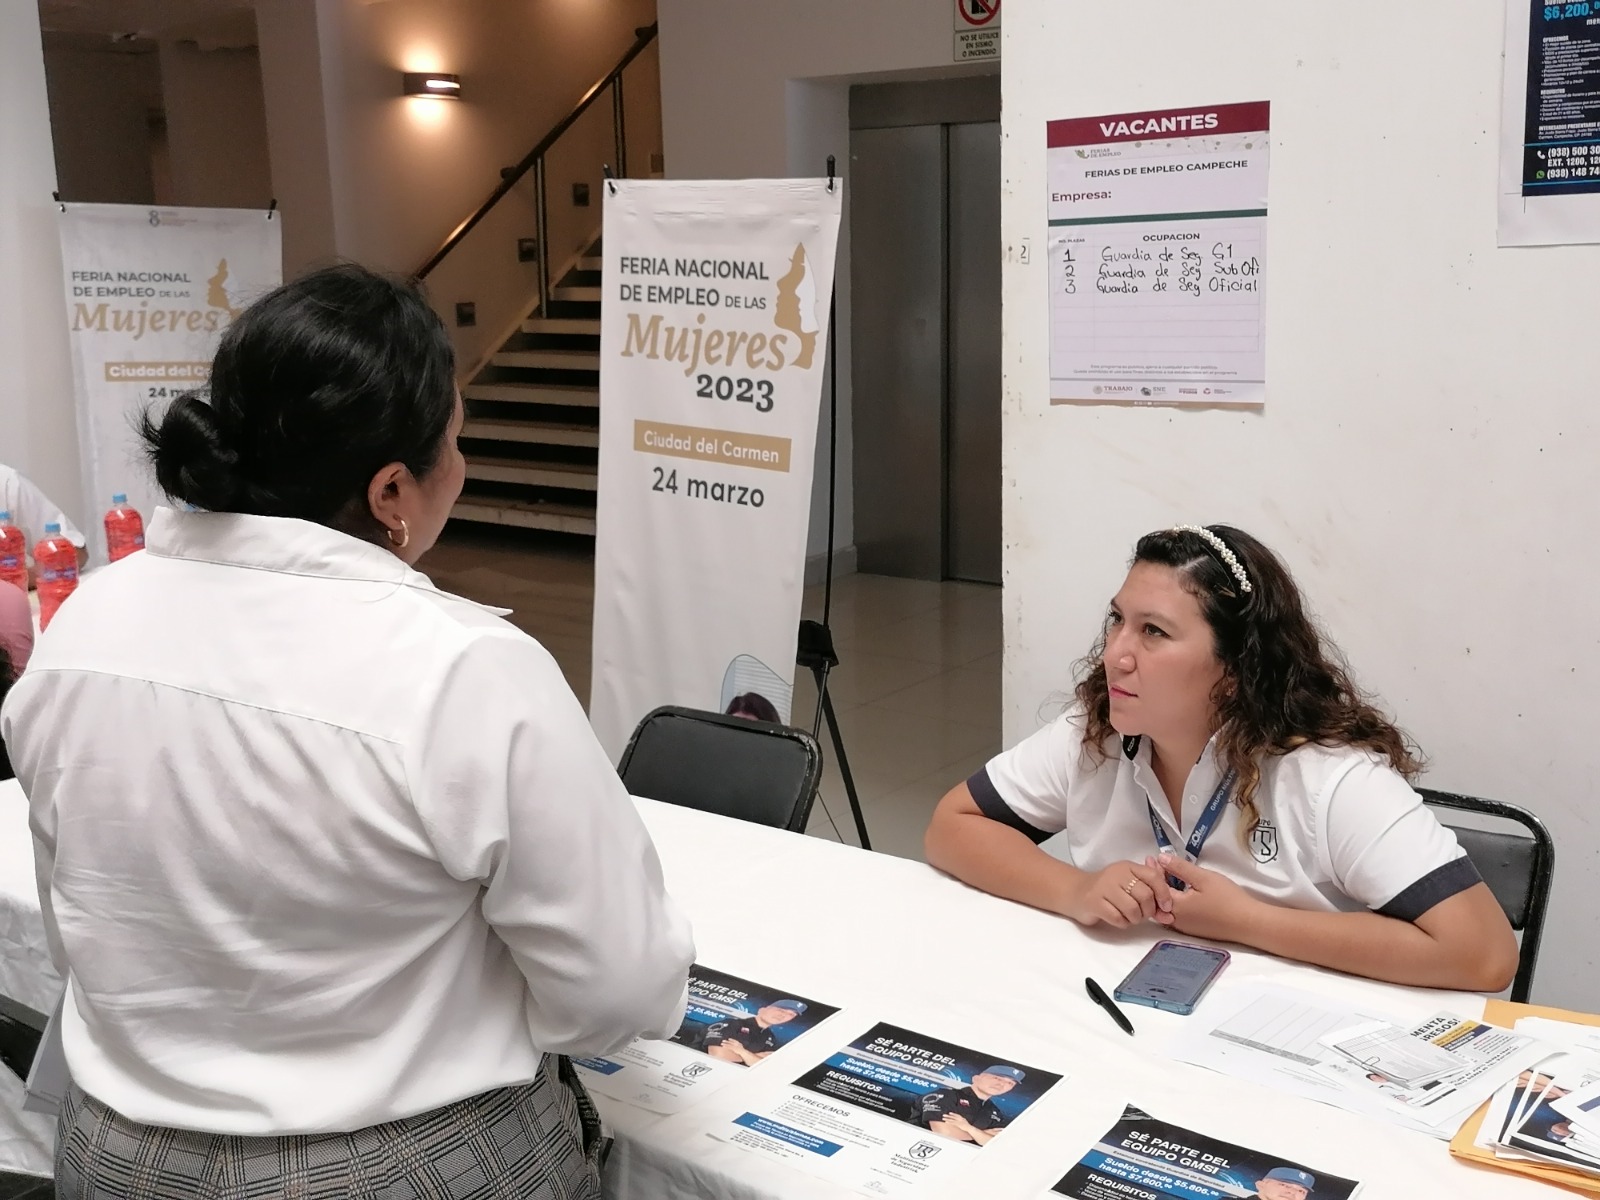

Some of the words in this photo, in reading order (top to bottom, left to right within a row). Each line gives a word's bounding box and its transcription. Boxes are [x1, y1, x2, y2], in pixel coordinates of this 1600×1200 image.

[978, 32, 999, 40] UTILICE
[968, 48, 996, 56] INCENDIO
[1099, 113, 1219, 137] VACANTES
[1548, 147, 1570, 158] (938)
[1571, 146, 1588, 156] 500
[1085, 168, 1121, 178] FERIAS
[1123, 167, 1137, 175] DE
[1140, 164, 1184, 175] EMPLEO
[1186, 160, 1249, 171] CAMPECHE
[1547, 158, 1564, 167] EXT.
[1566, 157, 1587, 166] 1200,
[1547, 168, 1569, 180] (938)
[1571, 167, 1587, 177] 148
[1052, 191, 1112, 203] Empresa:
[1143, 233, 1200, 242] OCUPACION
[1063, 249, 1076, 262] 1
[1102, 246, 1152, 262] Guardia
[1158, 247, 1173, 262] de
[72, 271, 112, 282] FERIA
[118, 272, 191, 283] NACIONAL
[620, 257, 670, 277] FERIA
[674, 259, 769, 281] NACIONAL
[1065, 265, 1075, 278] 2
[1099, 264, 1146, 280] Guardia
[1155, 264, 1169, 277] de
[1182, 263, 1201, 280] Seg
[73, 286, 93, 298] DE
[97, 286, 155, 298] EMPLEO
[159, 290, 171, 298] DE
[1065, 279, 1076, 294] 3
[1097, 277, 1138, 294] Guardia
[1152, 278, 1167, 292] de
[1179, 278, 1200, 296] Seg
[1209, 276, 1257, 293] Oficial
[620, 284, 642, 302] DE
[647, 286, 720, 306] EMPLEO
[724, 295, 741, 308] DE
[744, 296, 767, 310] LAS
[72, 301, 221, 341] Mujeres
[620, 312, 788, 378] Mujeres
[109, 364, 166, 378] Ciudad
[168, 364, 191, 377] del
[149, 387, 167, 398] 24
[696, 374, 774, 412] 2023
[644, 430, 692, 452] Ciudad
[695, 437, 718, 455] del
[722, 441, 779, 464] Carmen
[652, 466, 678, 494] 24
[687, 477, 764, 508] marzo
[1210, 790, 1224, 811] GRUPO
[694, 980, 729, 994] PARTE
[727, 989, 749, 1000] DEL
[708, 992, 738, 1004] GMSI
[865, 1043, 912, 1061] EQUIPO
[912, 1057, 945, 1071] GMSI
[875, 1037, 894, 1047] SÉ
[892, 1042, 932, 1058] PARTE
[932, 1054, 956, 1066] DEL
[839, 1063, 862, 1074] hasta
[846, 1057, 874, 1070] Sueldo
[875, 1065, 901, 1079] desde
[826, 1070, 882, 1092] REQUISITOS
[792, 1094, 851, 1117] OFRECEMOS
[1121, 1139, 1178, 1161] EQUIPO
[1179, 1158, 1220, 1175] GMSI
[1128, 1131, 1150, 1143] SÉ
[1151, 1137, 1200, 1158] PARTE
[1201, 1153, 1231, 1168] DEL
[1099, 1163, 1127, 1177] hasta
[1104, 1157, 1140, 1173] Sueldo
[1141, 1168, 1172, 1183] desde
[1087, 1173, 1157, 1200] REQUISITOS
